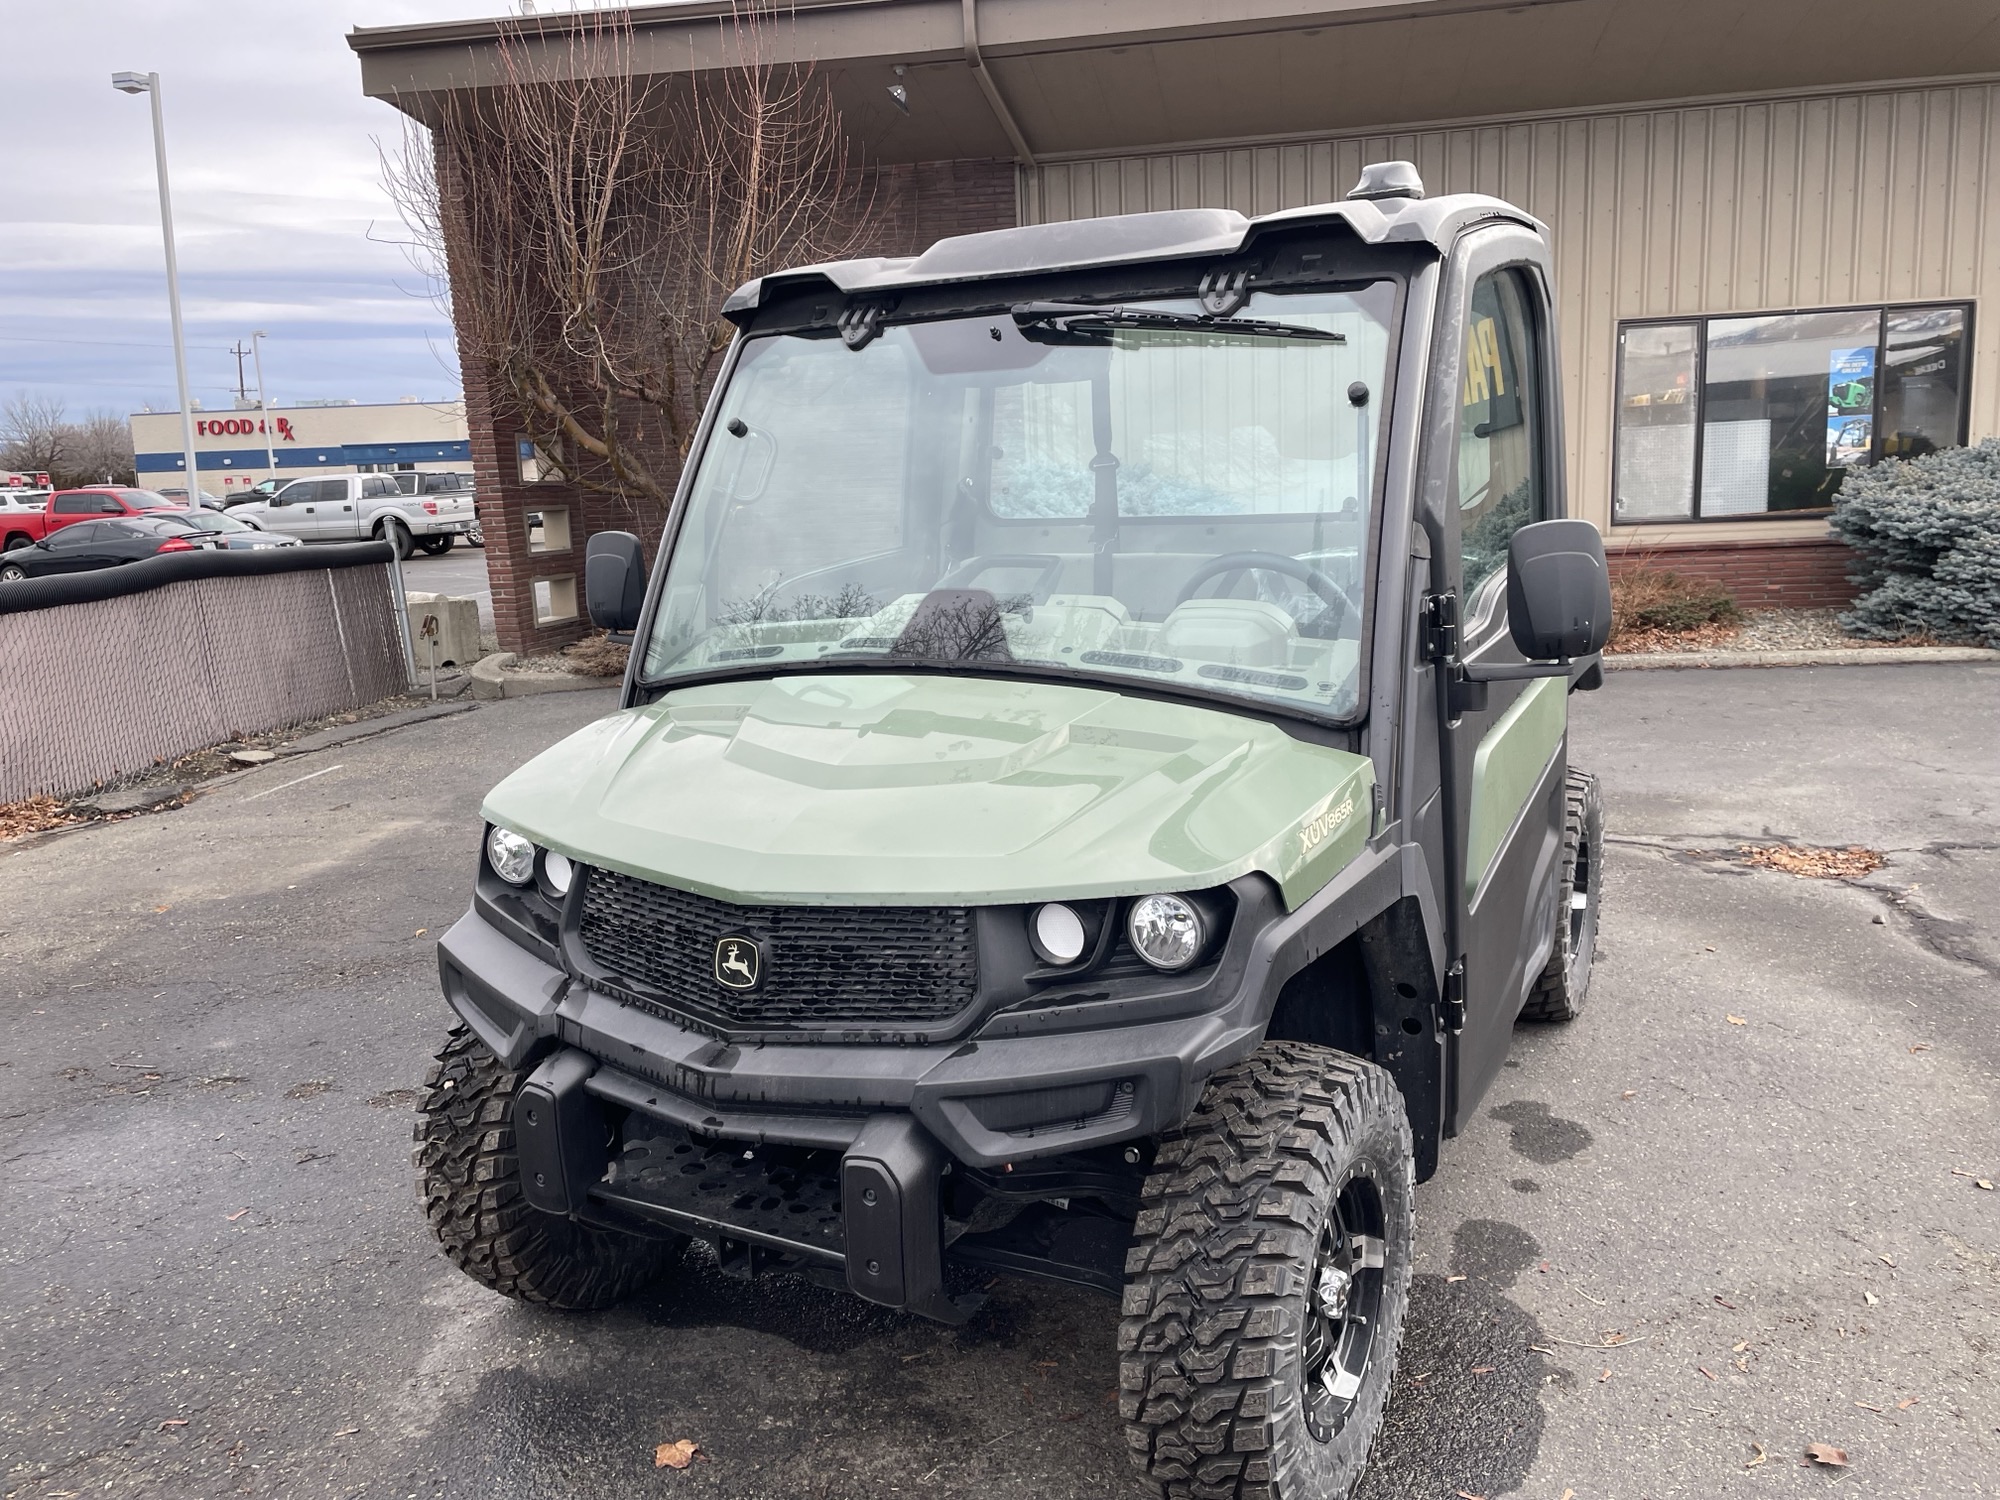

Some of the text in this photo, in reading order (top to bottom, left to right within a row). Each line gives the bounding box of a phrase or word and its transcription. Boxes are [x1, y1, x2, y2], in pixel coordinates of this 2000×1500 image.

[197, 419, 254, 436] FOOD
[258, 419, 272, 435] &
[1298, 797, 1354, 856] XUV865R
